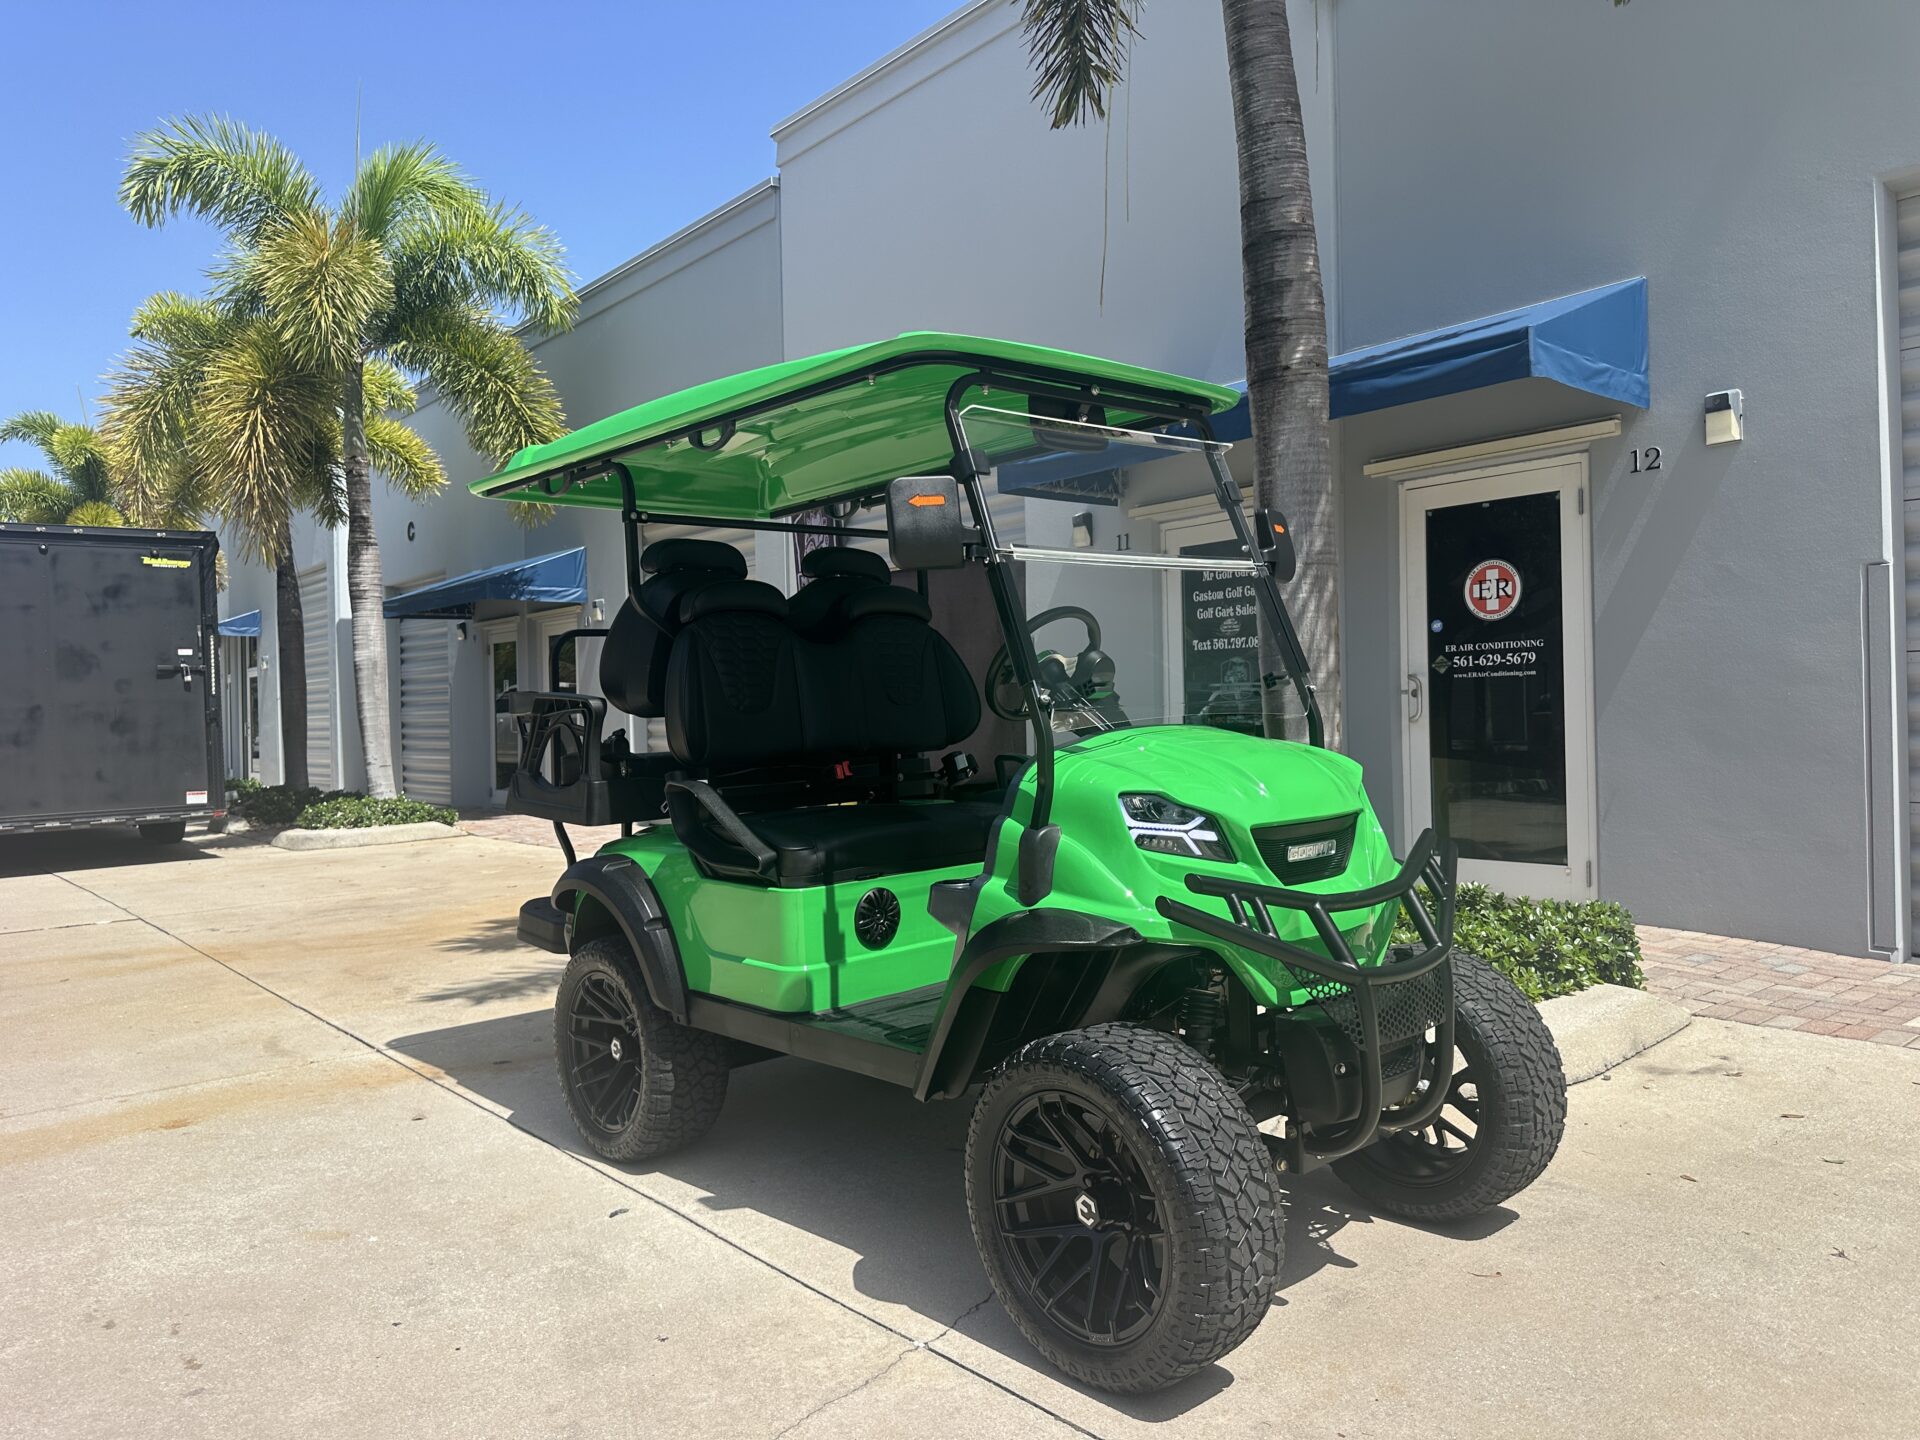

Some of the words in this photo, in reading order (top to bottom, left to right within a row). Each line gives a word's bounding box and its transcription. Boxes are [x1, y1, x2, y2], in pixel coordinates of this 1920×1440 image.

[1630, 447, 1662, 474] 12
[407, 520, 416, 542] C
[1115, 532, 1131, 551] 11
[1225, 586, 1244, 599] Golf
[1244, 585, 1256, 597] Ca
[1478, 577, 1512, 601] ER
[1197, 607, 1214, 620] Golf
[1215, 606, 1235, 618] Cart
[1192, 639, 1212, 651] Text
[1213, 636, 1259, 650] 561.797.08
[1445, 644, 1457, 653] ER
[1458, 643, 1474, 652] AIR
[1475, 639, 1544, 650] CONDITIONING
[1452, 651, 1536, 668] 561-629-5679
